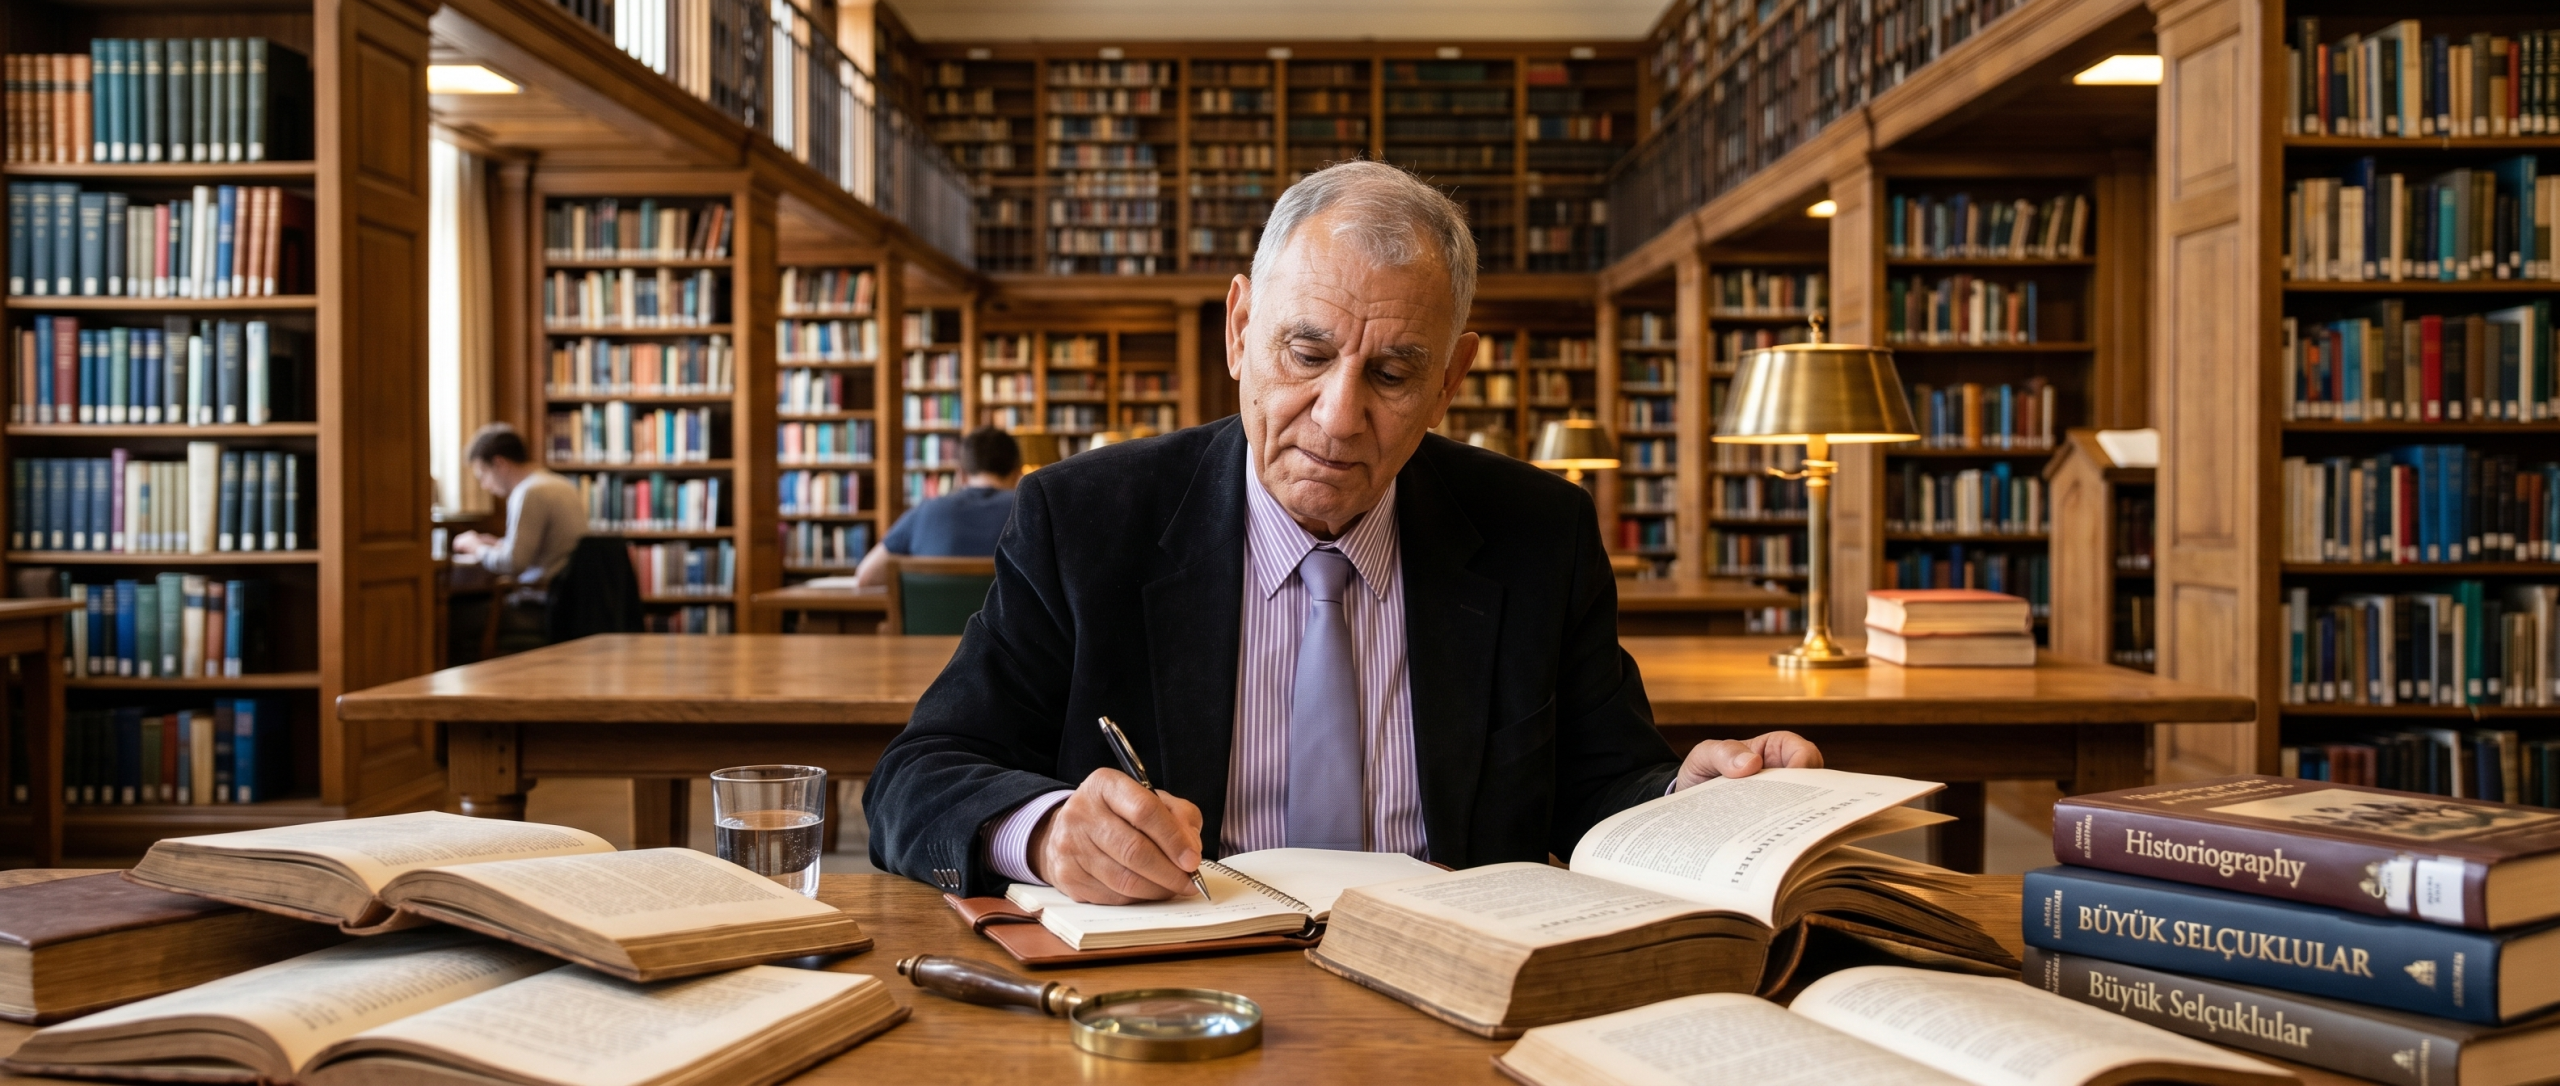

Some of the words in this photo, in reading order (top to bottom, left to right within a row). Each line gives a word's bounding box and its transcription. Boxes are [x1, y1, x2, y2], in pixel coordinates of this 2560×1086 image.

[2125, 828, 2306, 889] Historiography
[2078, 904, 2168, 943] BÜYÜK
[2173, 920, 2374, 978] SELÇUKLULAR
[2088, 970, 2163, 1015] Büyük
[2169, 991, 2313, 1048] Selçuklular
